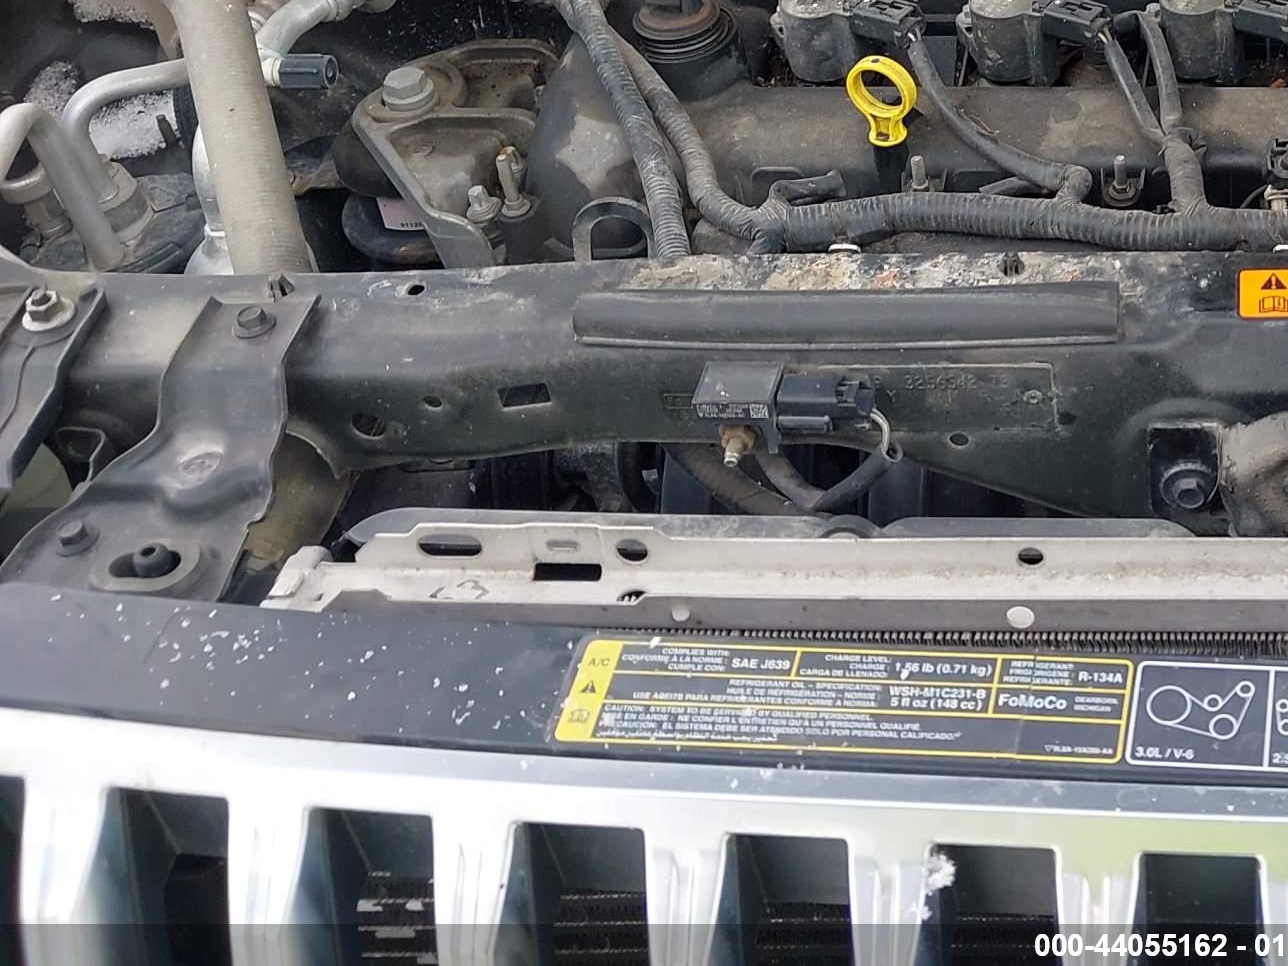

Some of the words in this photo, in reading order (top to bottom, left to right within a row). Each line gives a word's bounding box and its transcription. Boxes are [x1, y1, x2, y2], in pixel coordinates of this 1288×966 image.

[587, 658, 610, 667] A/C
[731, 658, 758, 670] SAE
[760, 660, 791, 671] J639
[921, 663, 936, 674] lb
[937, 663, 968, 676] (0.71
[970, 665, 993, 677] kg)
[1078, 671, 1123, 683] R-134A
[889, 686, 987, 700] WSH-M1C231-B
[914, 700, 928, 709] oz
[930, 698, 958, 710] (148
[998, 694, 1068, 709] FoMoCo
[1135, 746, 1163, 758] 3.0L
[1172, 748, 1195, 760] V-6
